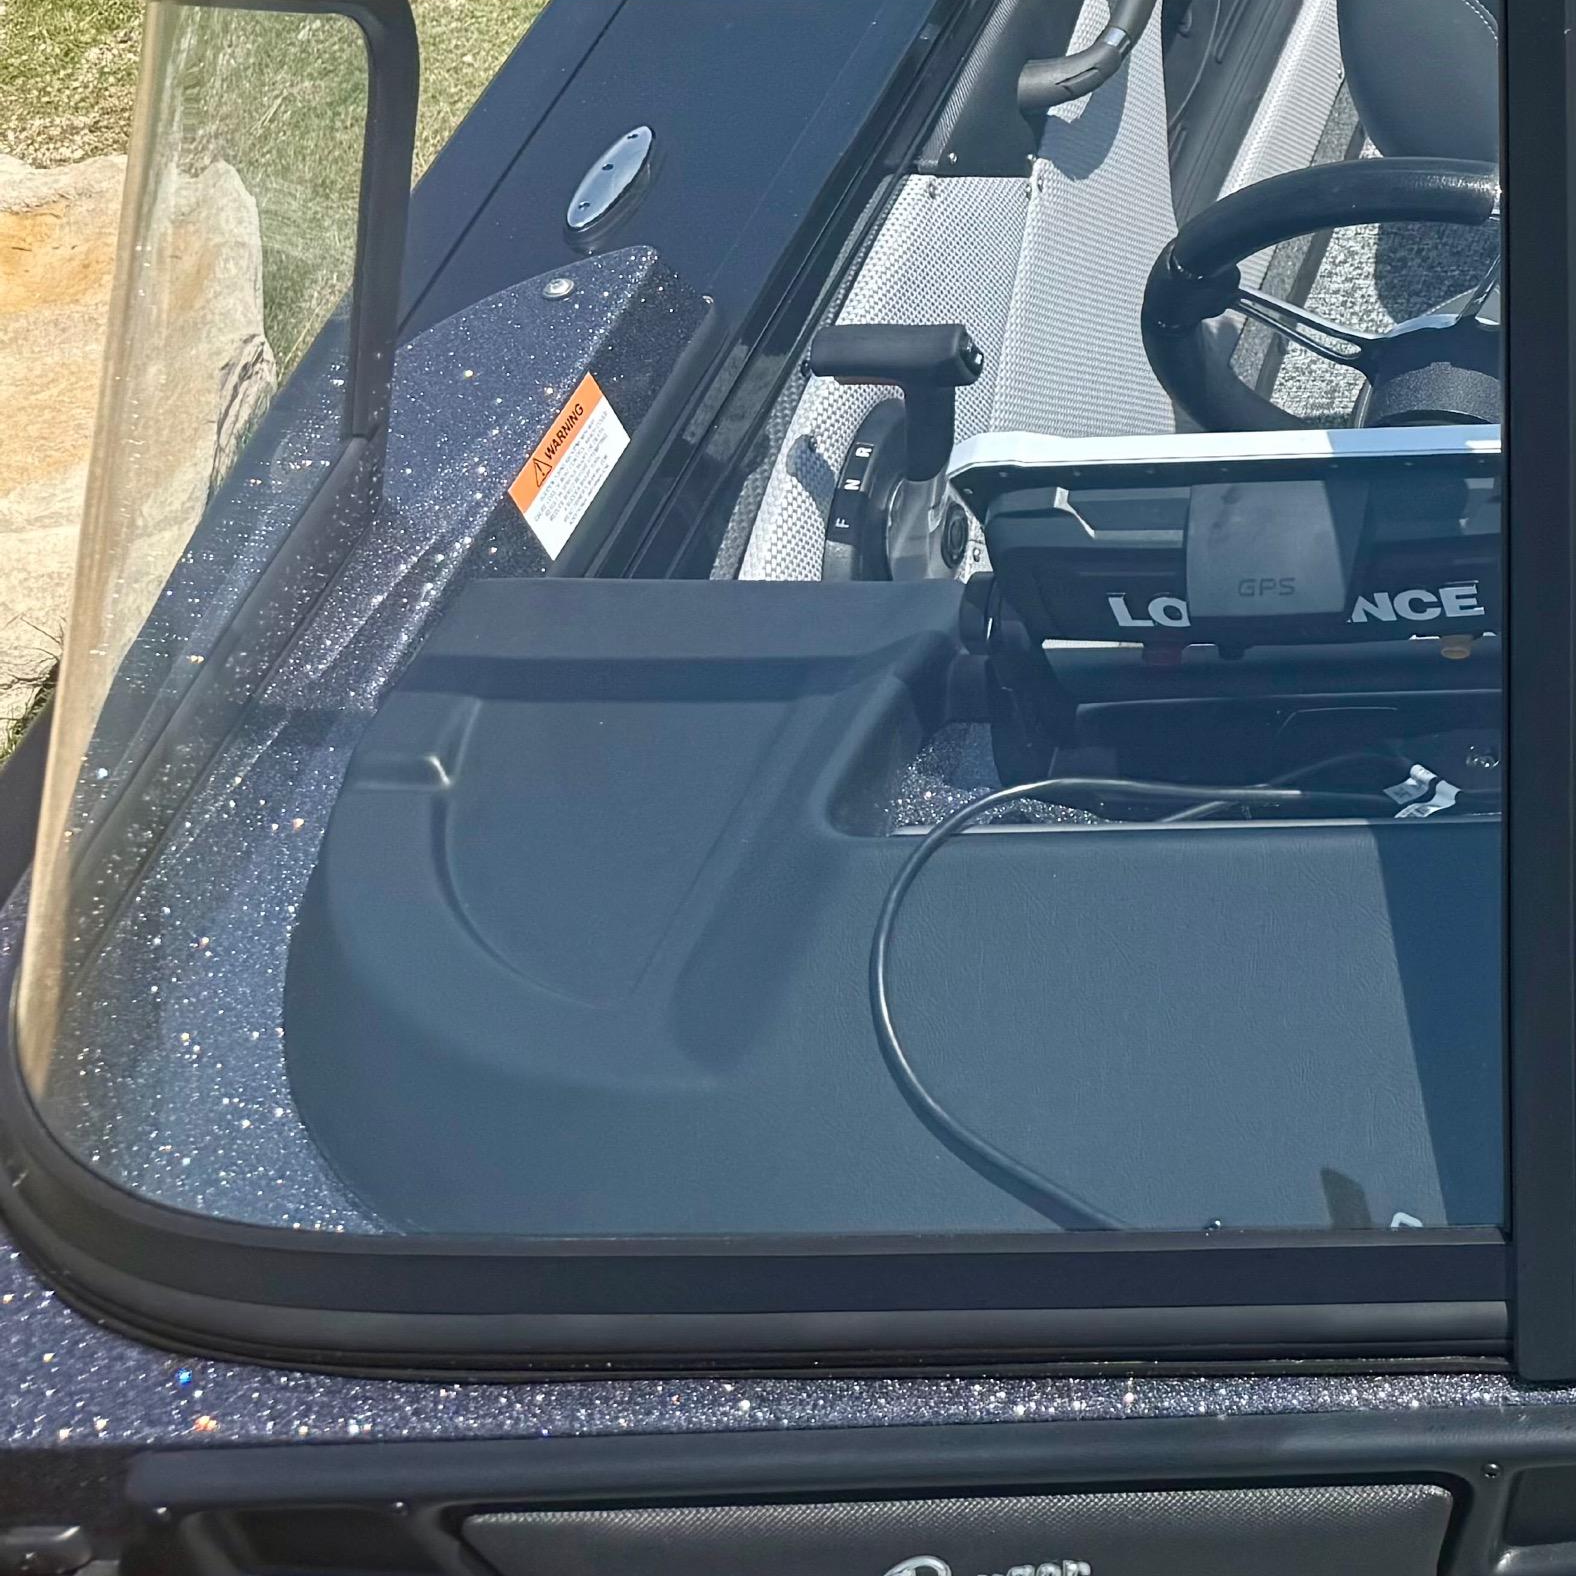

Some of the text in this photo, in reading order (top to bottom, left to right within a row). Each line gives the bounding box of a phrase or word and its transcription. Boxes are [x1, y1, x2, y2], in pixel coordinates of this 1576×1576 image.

[544, 403, 584, 460] WARNING
[855, 446, 873, 458] R
[844, 478, 861, 491] N
[835, 517, 850, 529] F
[1238, 577, 1297, 597] GPS
[1106, 580, 1486, 628] LONCE
